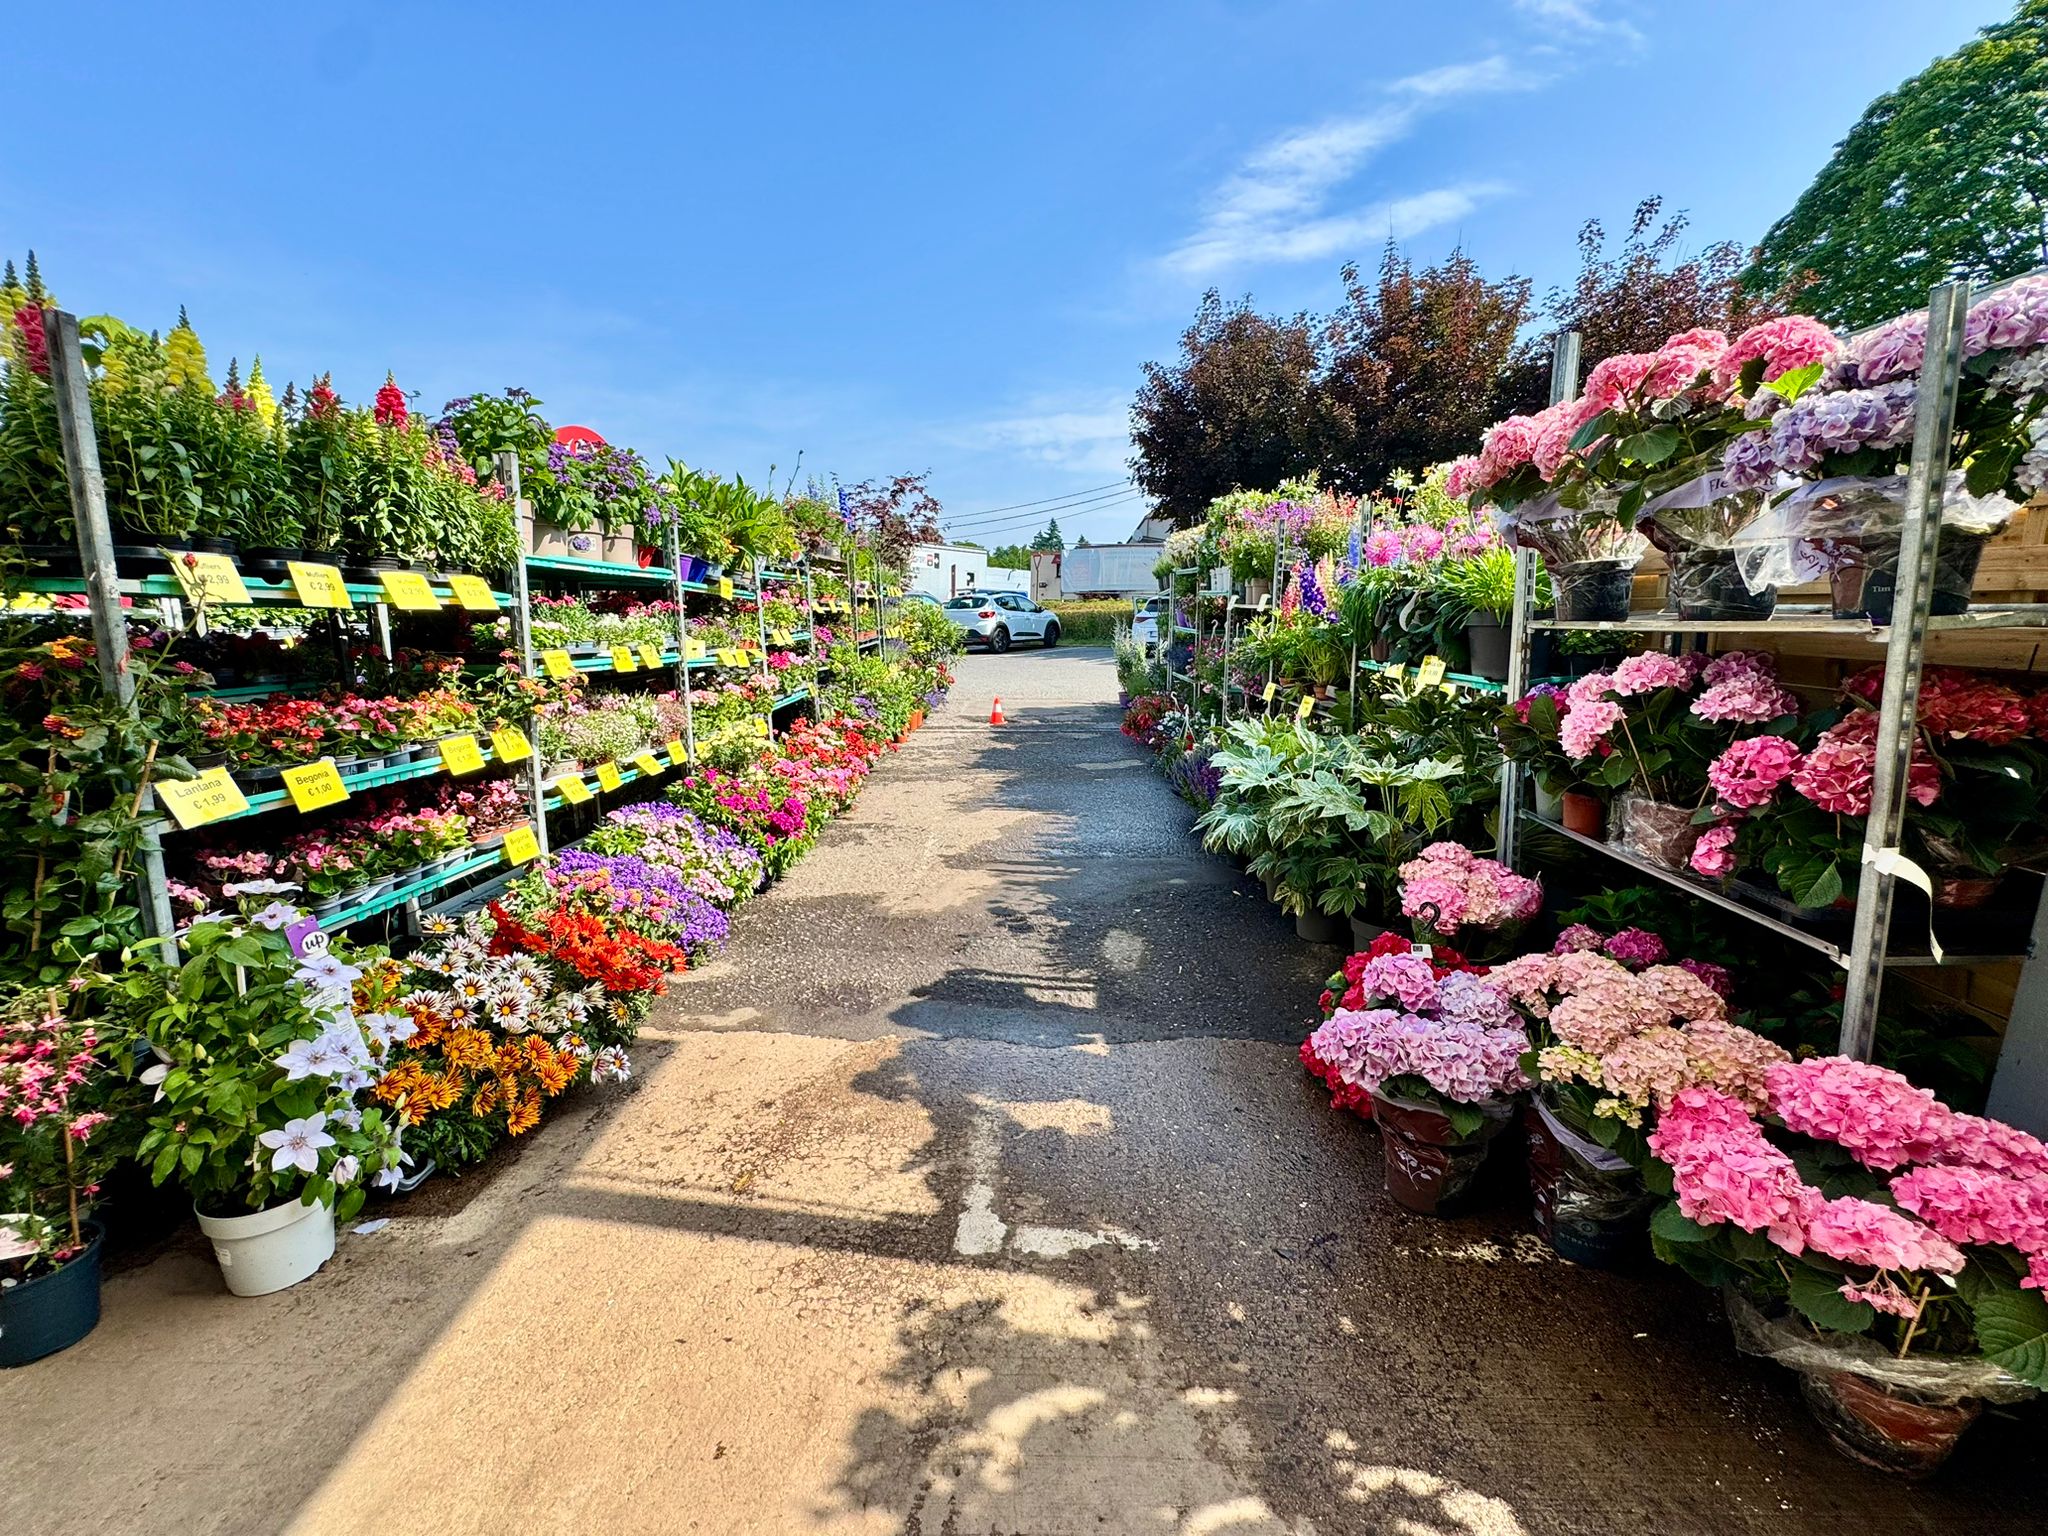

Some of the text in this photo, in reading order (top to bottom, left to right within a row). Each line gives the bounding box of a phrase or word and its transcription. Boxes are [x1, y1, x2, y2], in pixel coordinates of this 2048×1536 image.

[295, 769, 330, 786] Begonia
[174, 778, 223, 798] Lantana
[305, 934, 324, 949] up
